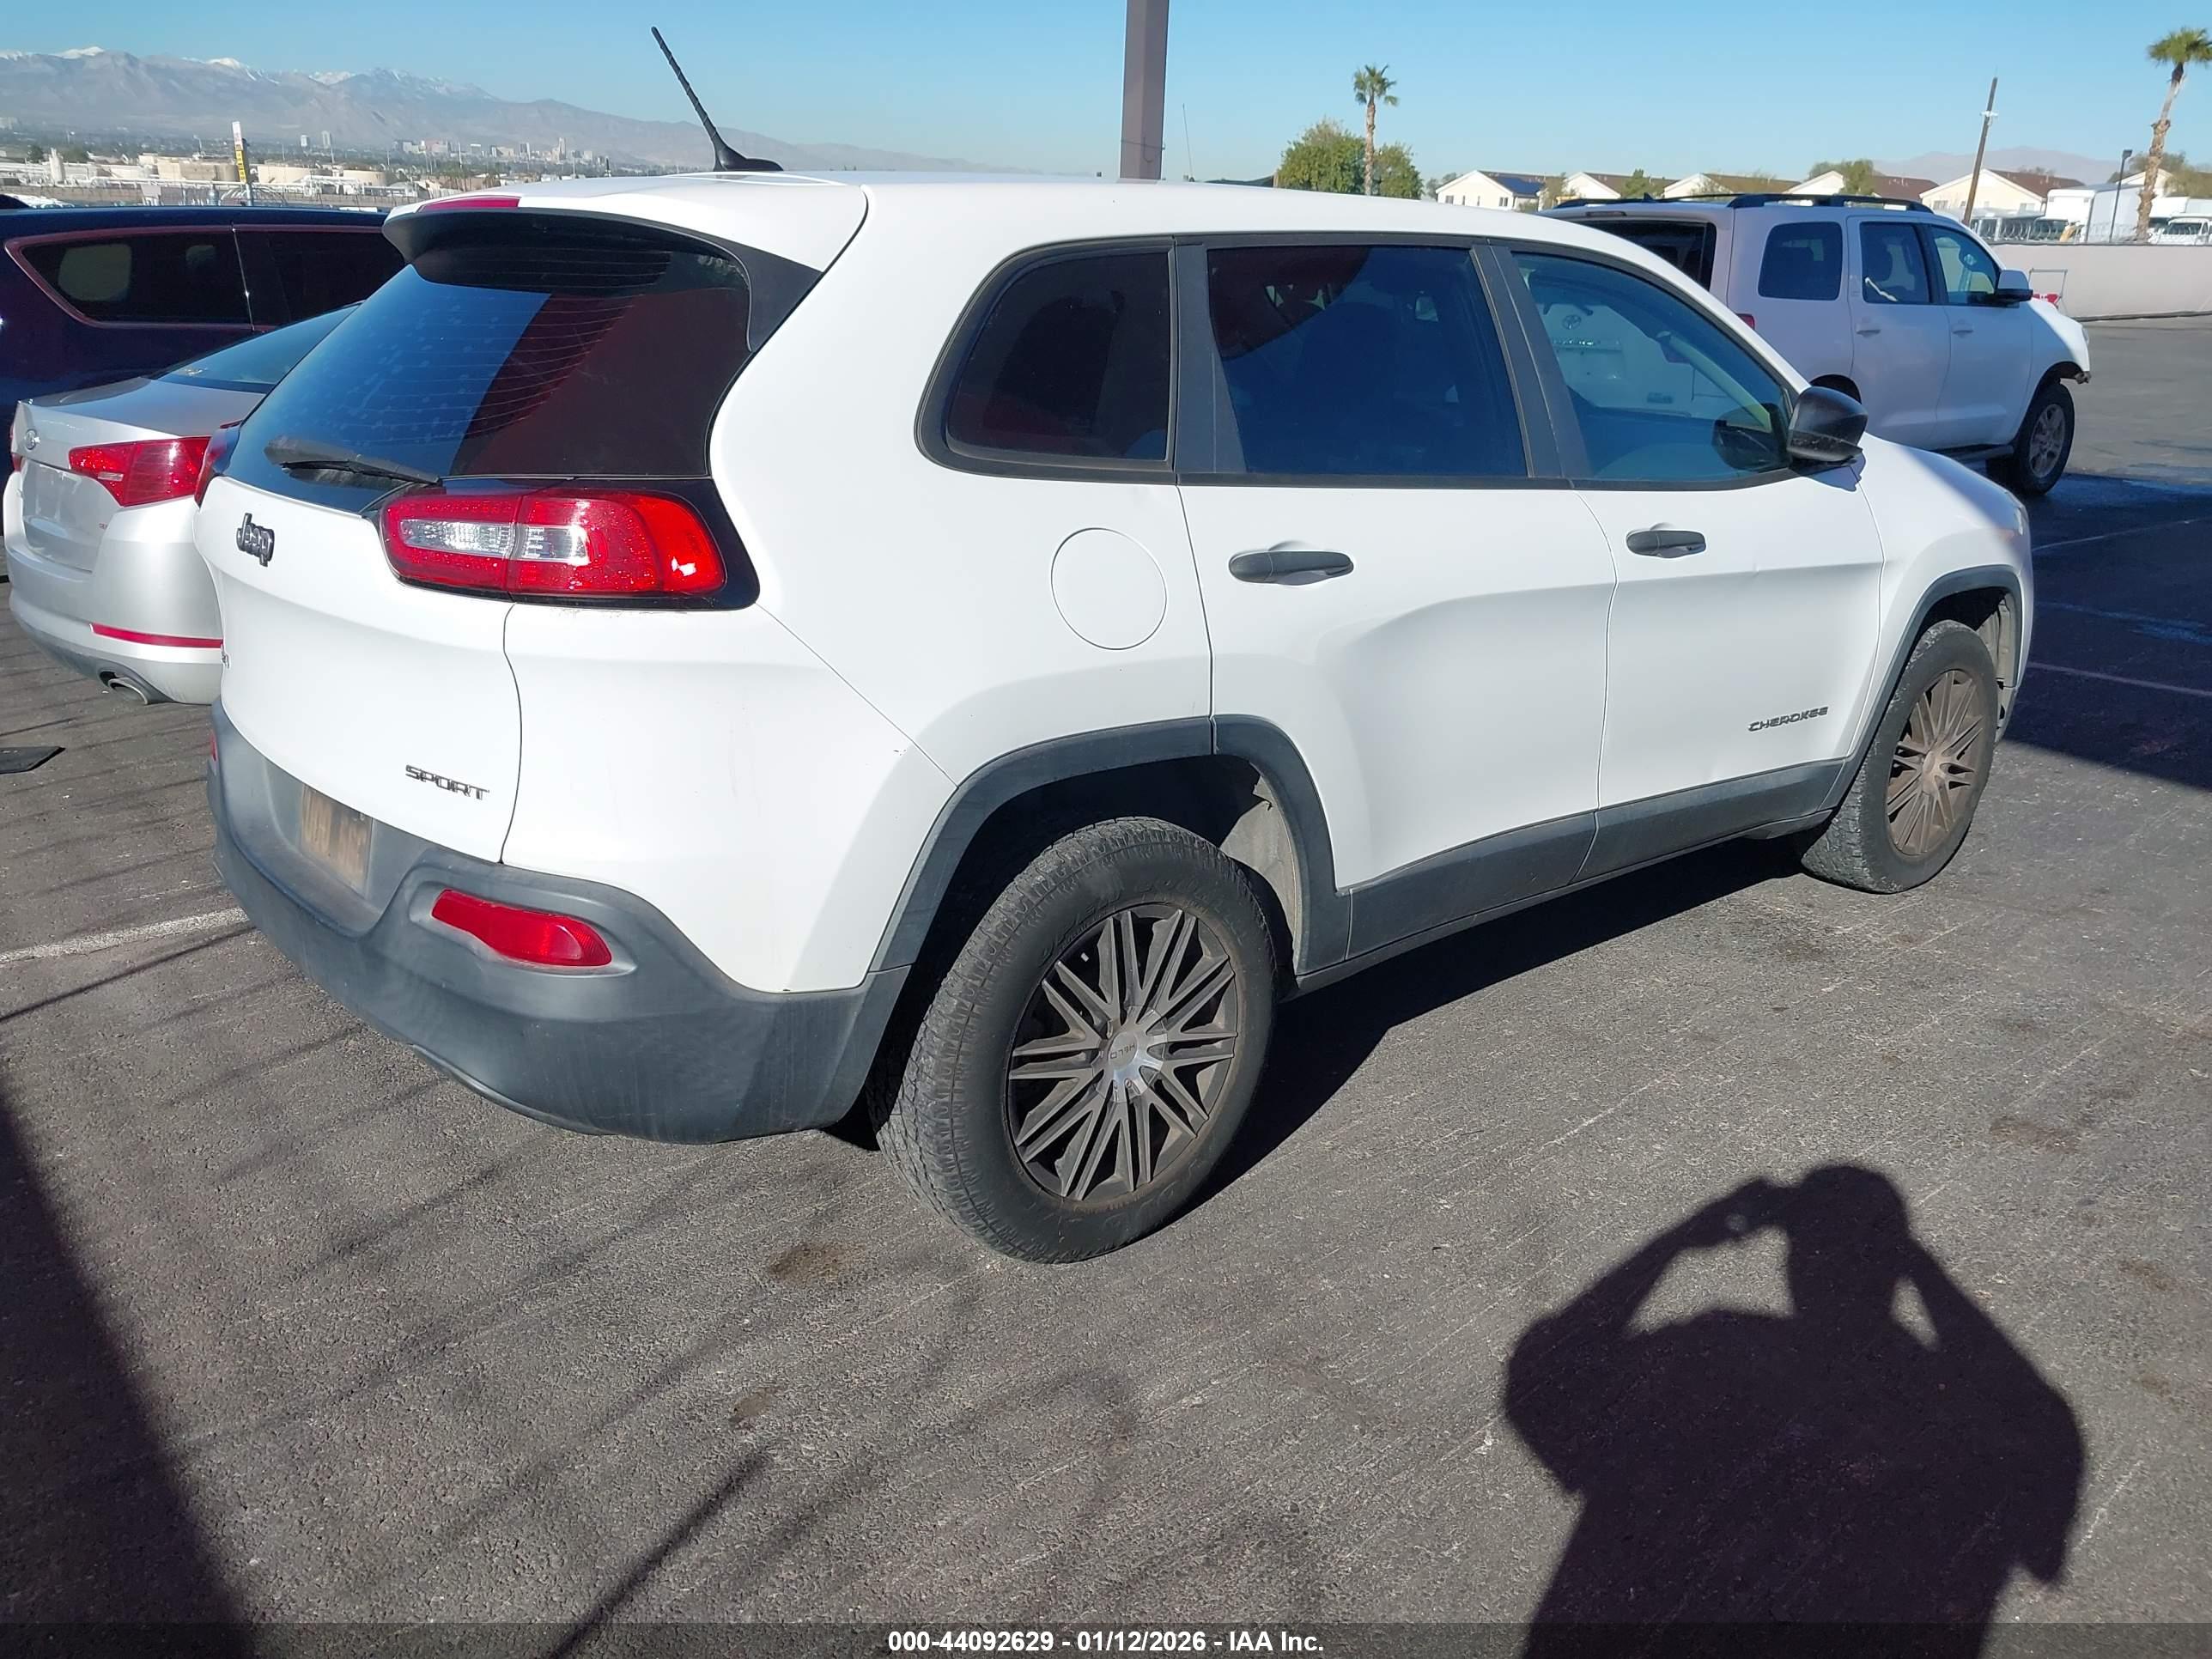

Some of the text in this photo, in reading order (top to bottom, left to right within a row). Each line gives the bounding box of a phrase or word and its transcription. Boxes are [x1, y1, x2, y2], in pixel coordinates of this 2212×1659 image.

[236, 513, 275, 567] Jeep
[1748, 706, 1829, 732] CHEROKEE
[405, 764, 489, 799] SPORT
